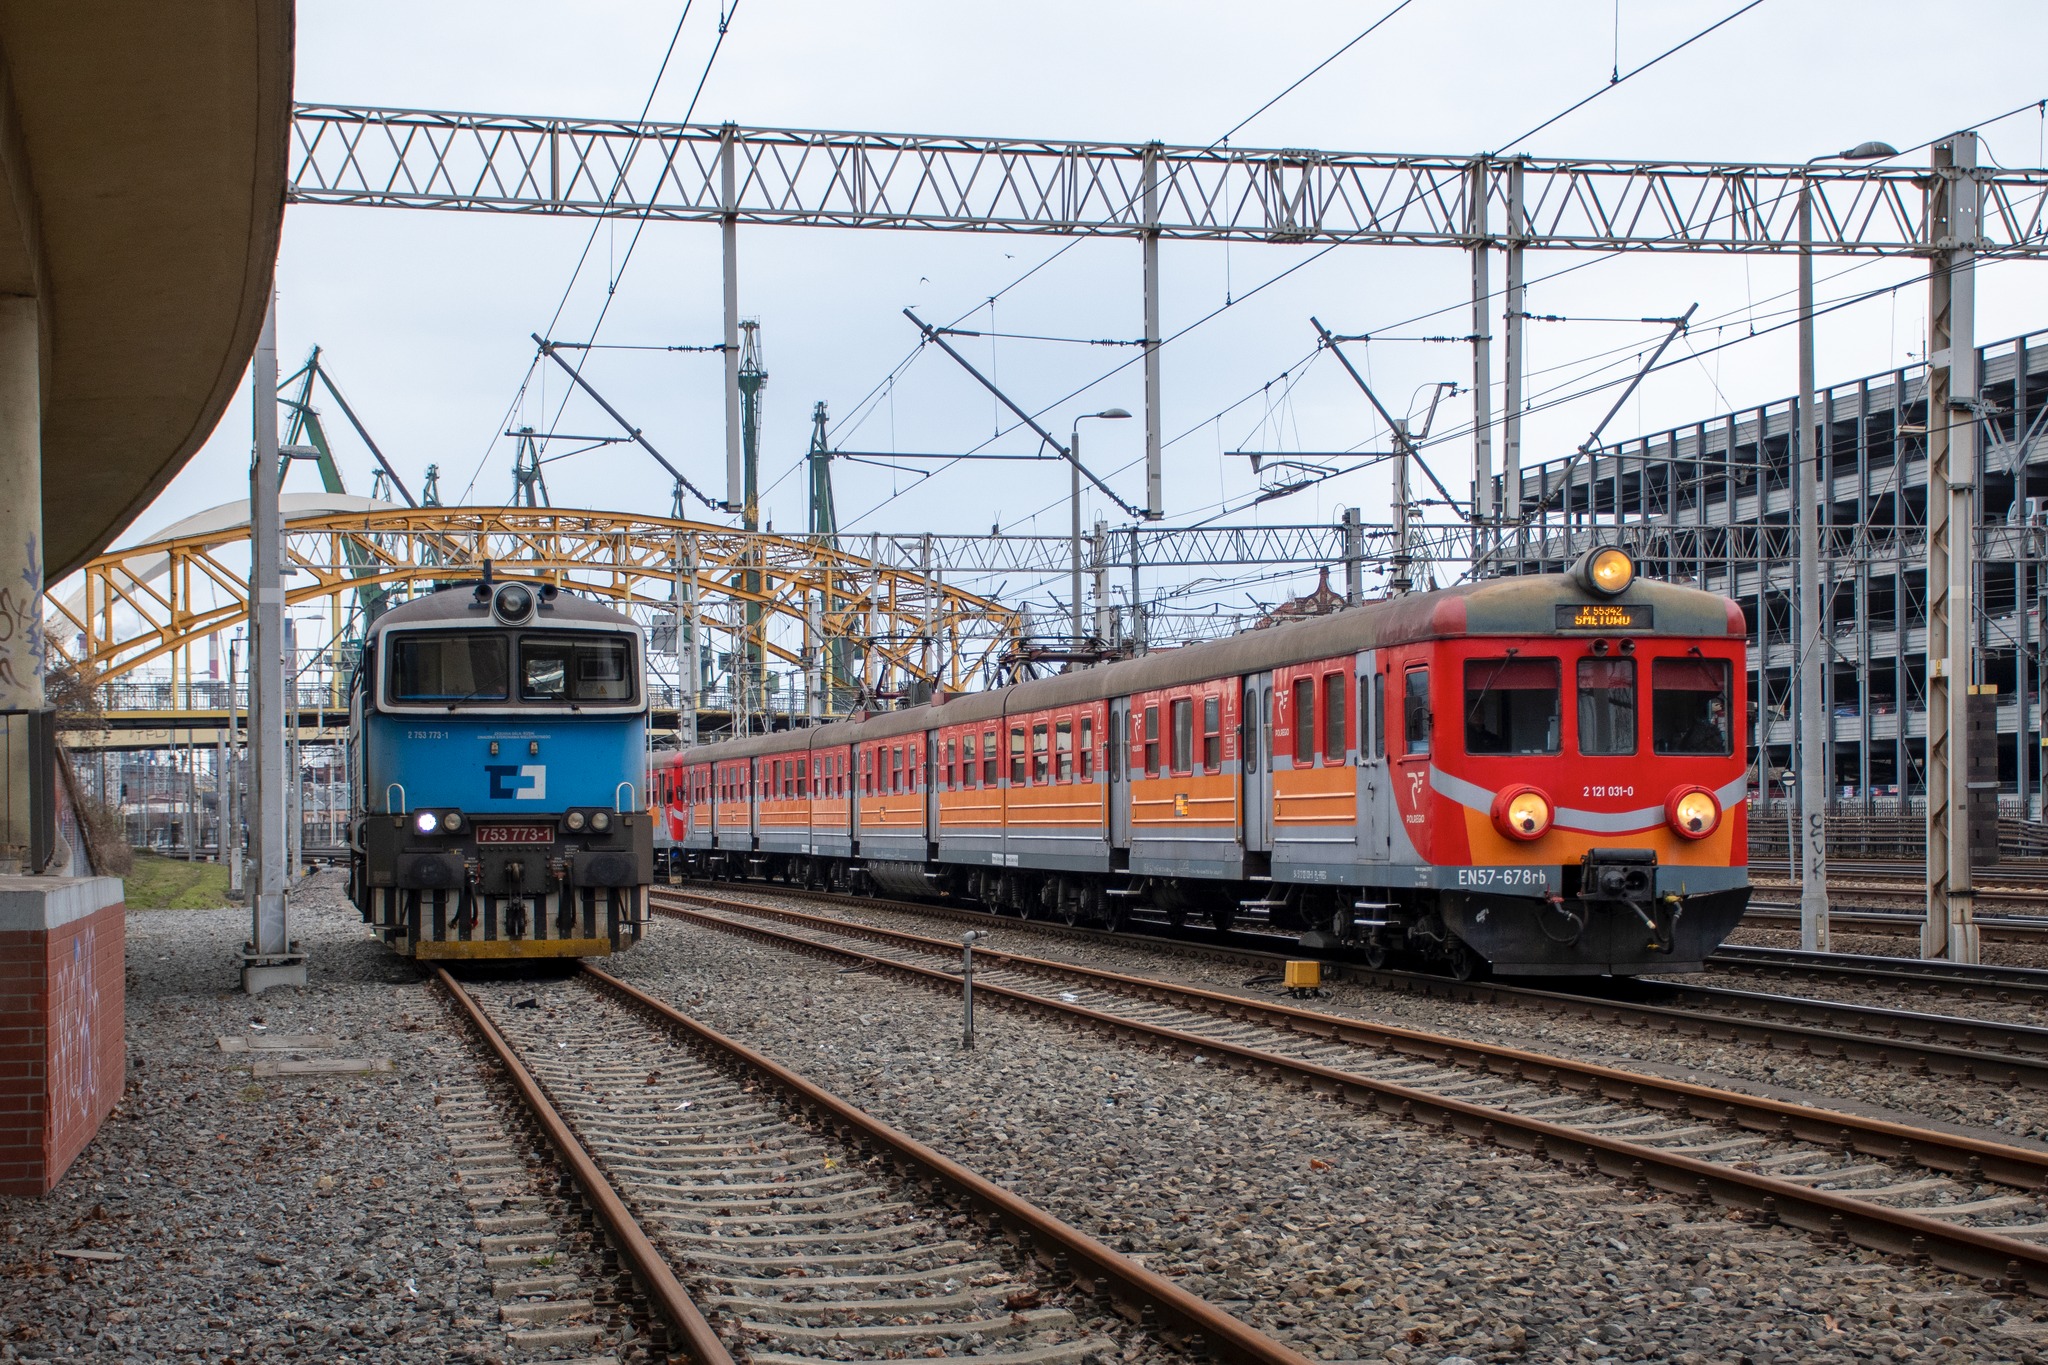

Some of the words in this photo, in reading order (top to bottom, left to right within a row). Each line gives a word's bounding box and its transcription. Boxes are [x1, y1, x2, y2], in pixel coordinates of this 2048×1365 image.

[407, 731, 413, 739] 2
[414, 731, 427, 739] 753
[428, 731, 449, 739] 773-1
[1583, 786, 1590, 797] 2
[1592, 786, 1605, 797] 121
[1608, 786, 1634, 797] 031-0
[1406, 815, 1425, 823] POLREGIO
[481, 828, 508, 841] 753
[511, 828, 551, 841] 773-1
[1458, 869, 1546, 885] EN57-678rb
